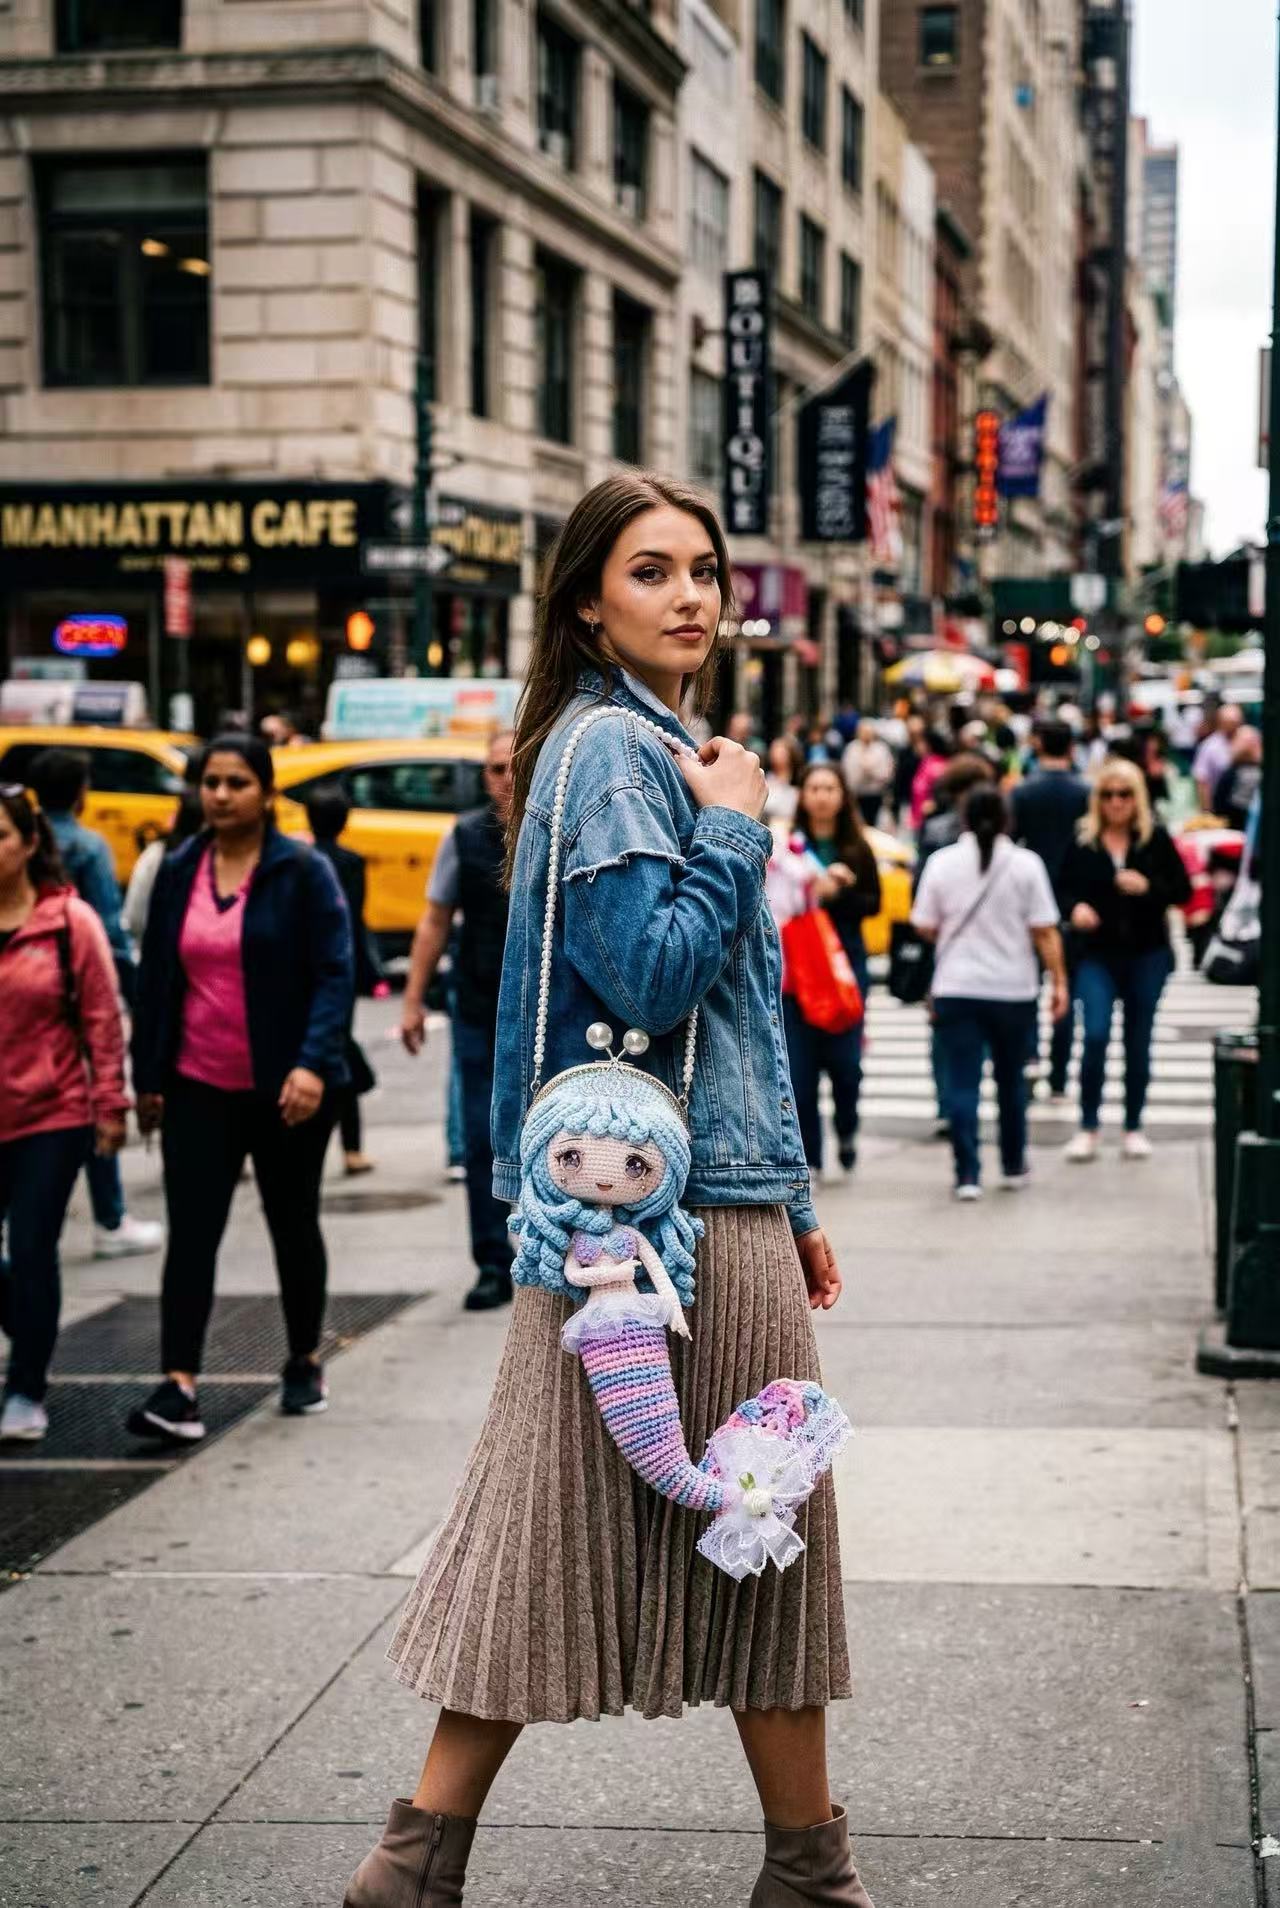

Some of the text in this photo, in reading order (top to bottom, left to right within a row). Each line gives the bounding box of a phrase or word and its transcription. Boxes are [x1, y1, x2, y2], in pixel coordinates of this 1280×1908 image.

[729, 279, 763, 528] BOUTIQUE
[2, 500, 358, 547] MANHATTAN CAFE
